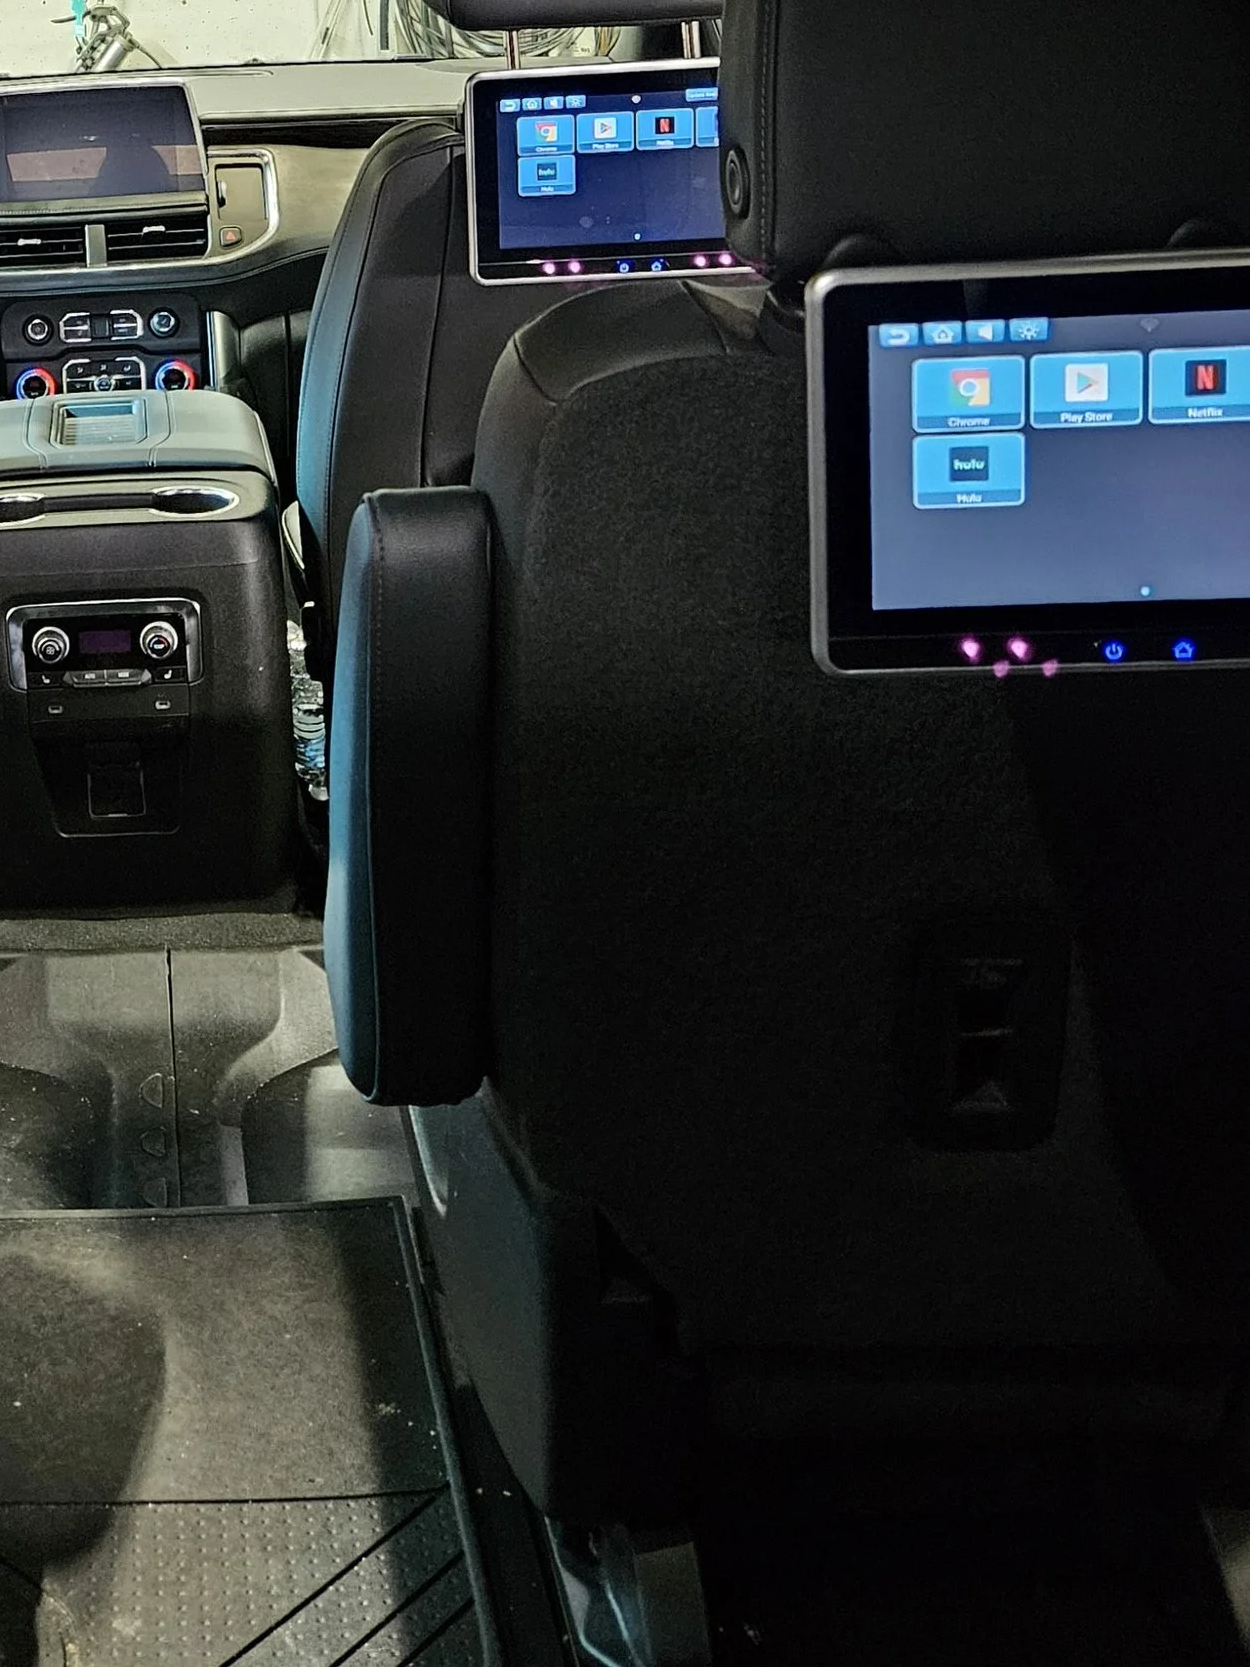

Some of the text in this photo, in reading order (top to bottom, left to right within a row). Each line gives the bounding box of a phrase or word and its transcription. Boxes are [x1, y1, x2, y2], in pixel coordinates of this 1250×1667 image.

[659, 118, 670, 133] N
[1197, 365, 1215, 391] N
[1060, 411, 1113, 424] Play Store
[1187, 407, 1224, 418] Netflix
[947, 417, 990, 427] Chrome
[953, 458, 986, 471] hulu
[956, 493, 982, 504] Hulu
